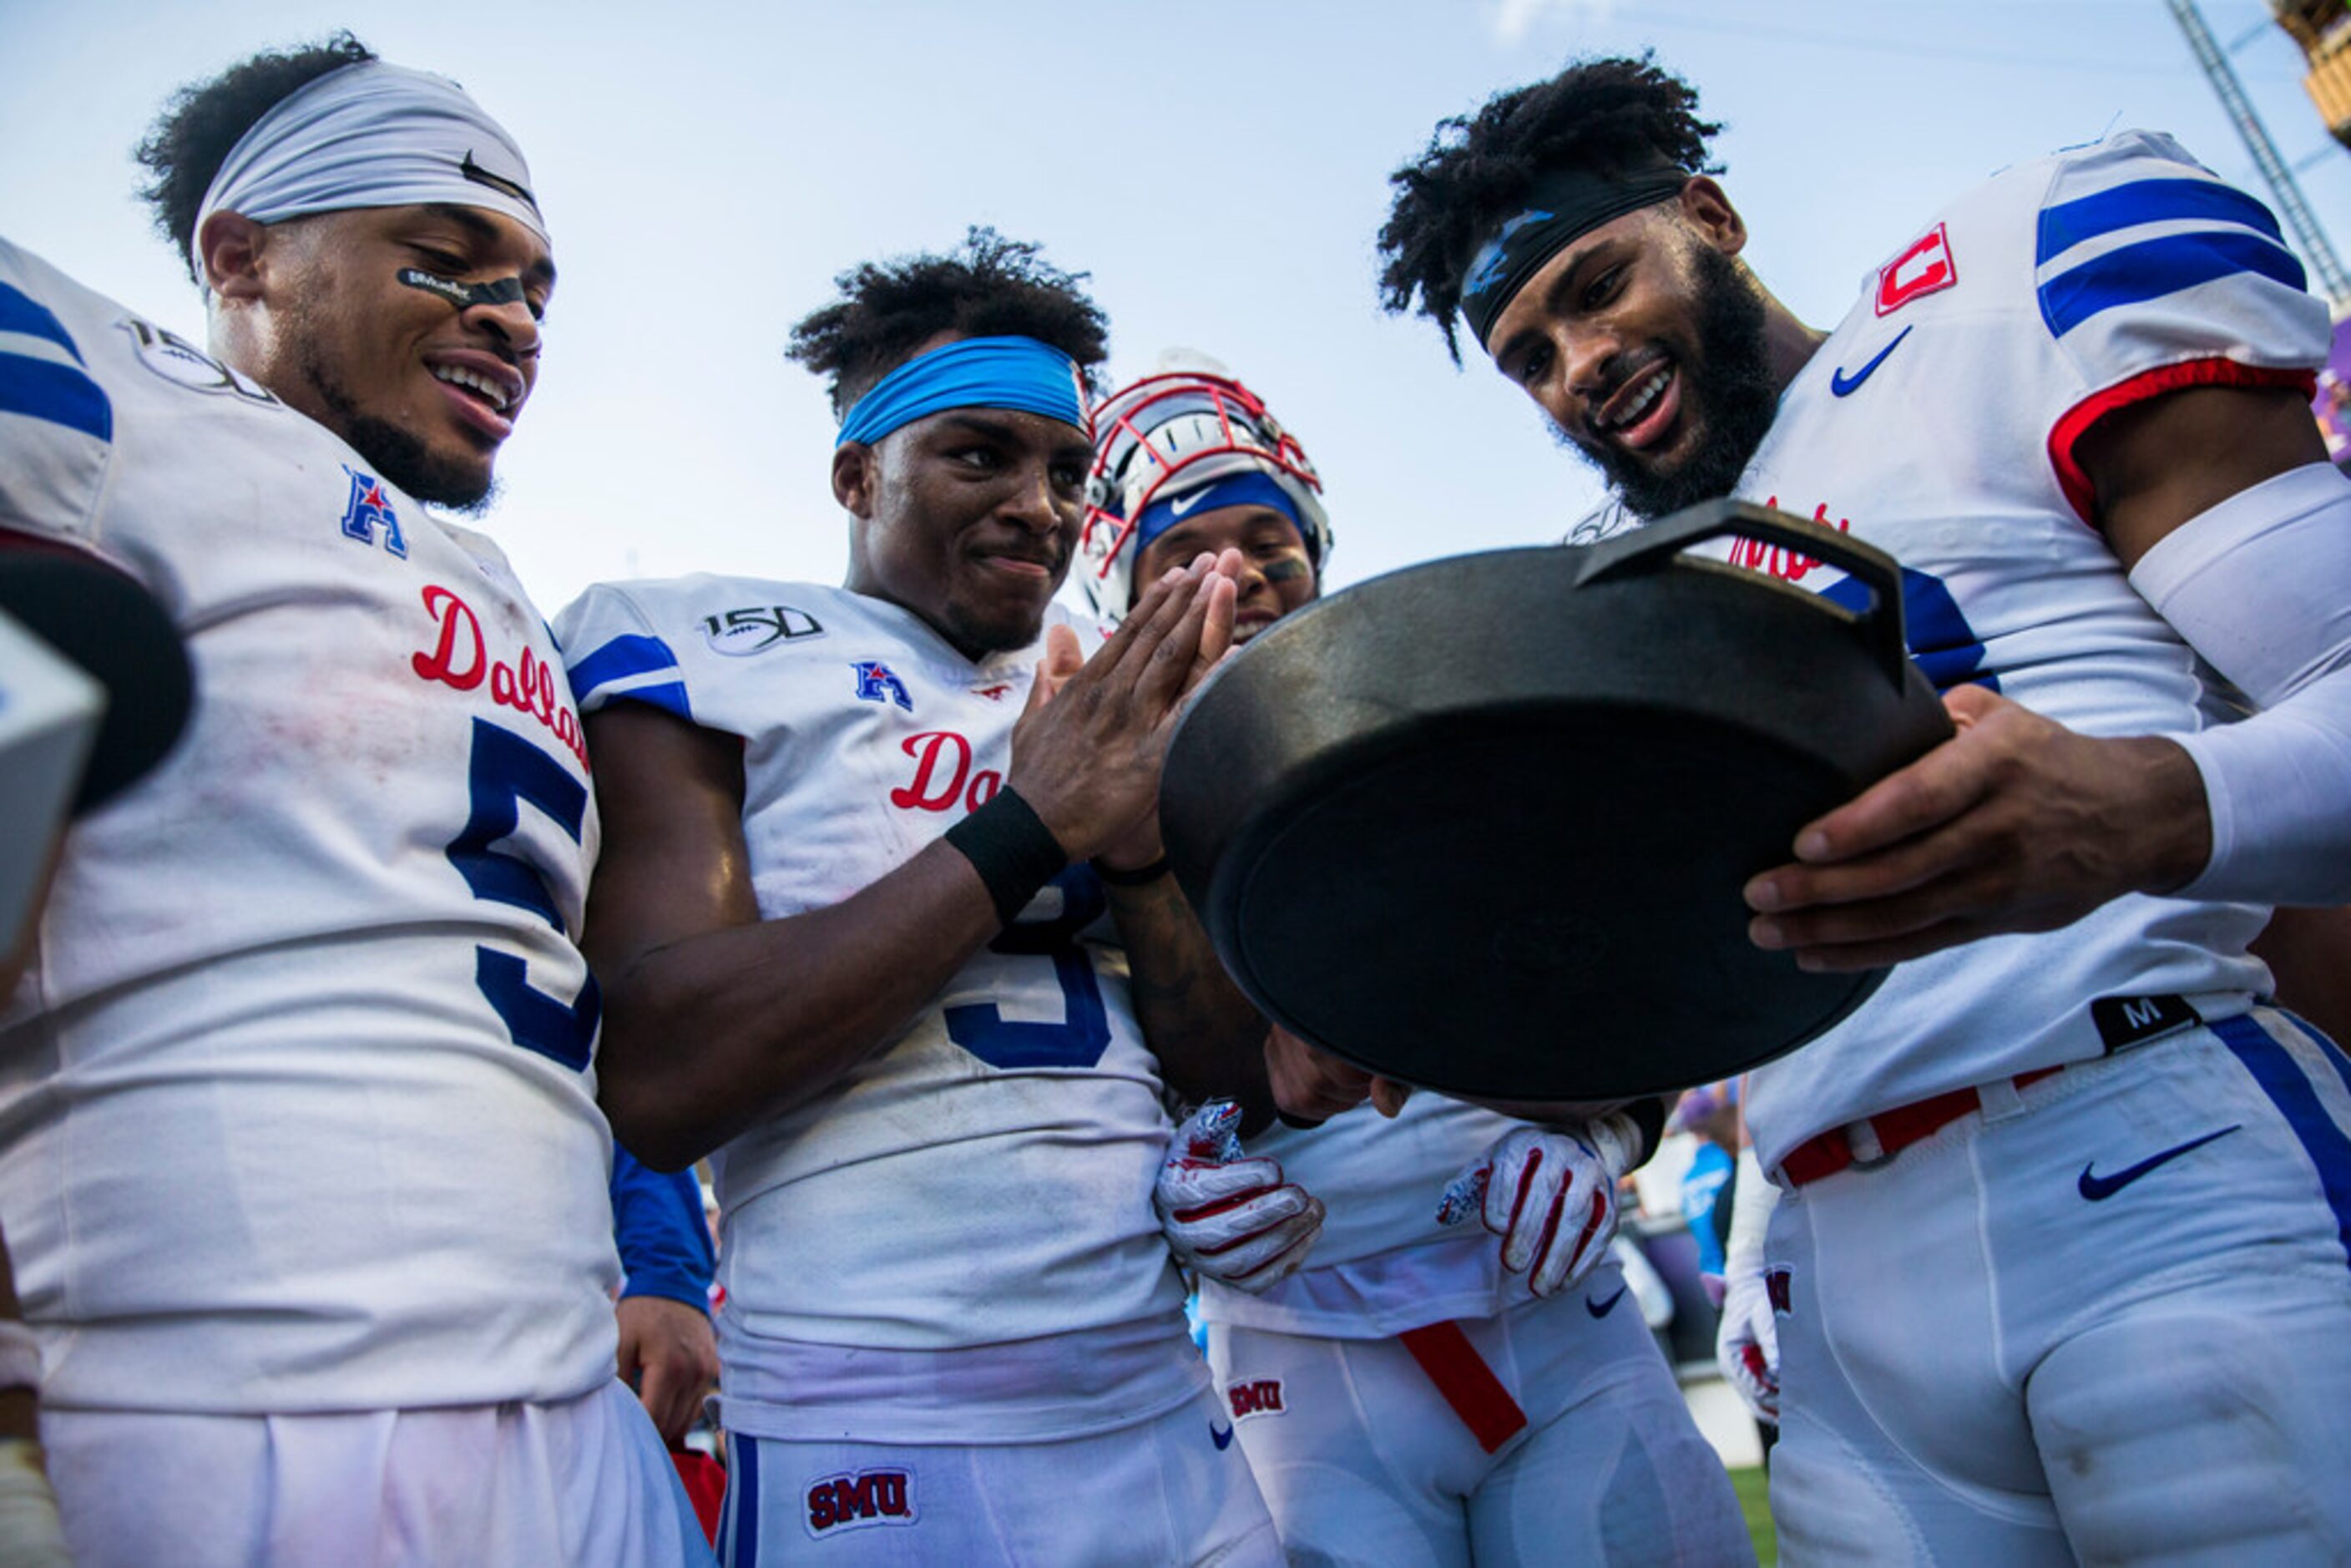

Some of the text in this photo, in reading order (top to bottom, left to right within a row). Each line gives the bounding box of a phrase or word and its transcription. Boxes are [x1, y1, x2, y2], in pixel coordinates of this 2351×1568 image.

[1881, 232, 1947, 306] C
[704, 605, 824, 650] 150
[446, 716, 602, 1074] 5
[2122, 997, 2162, 1029] M
[1228, 1379, 1282, 1419] SMU
[808, 1473, 908, 1531] SMU
